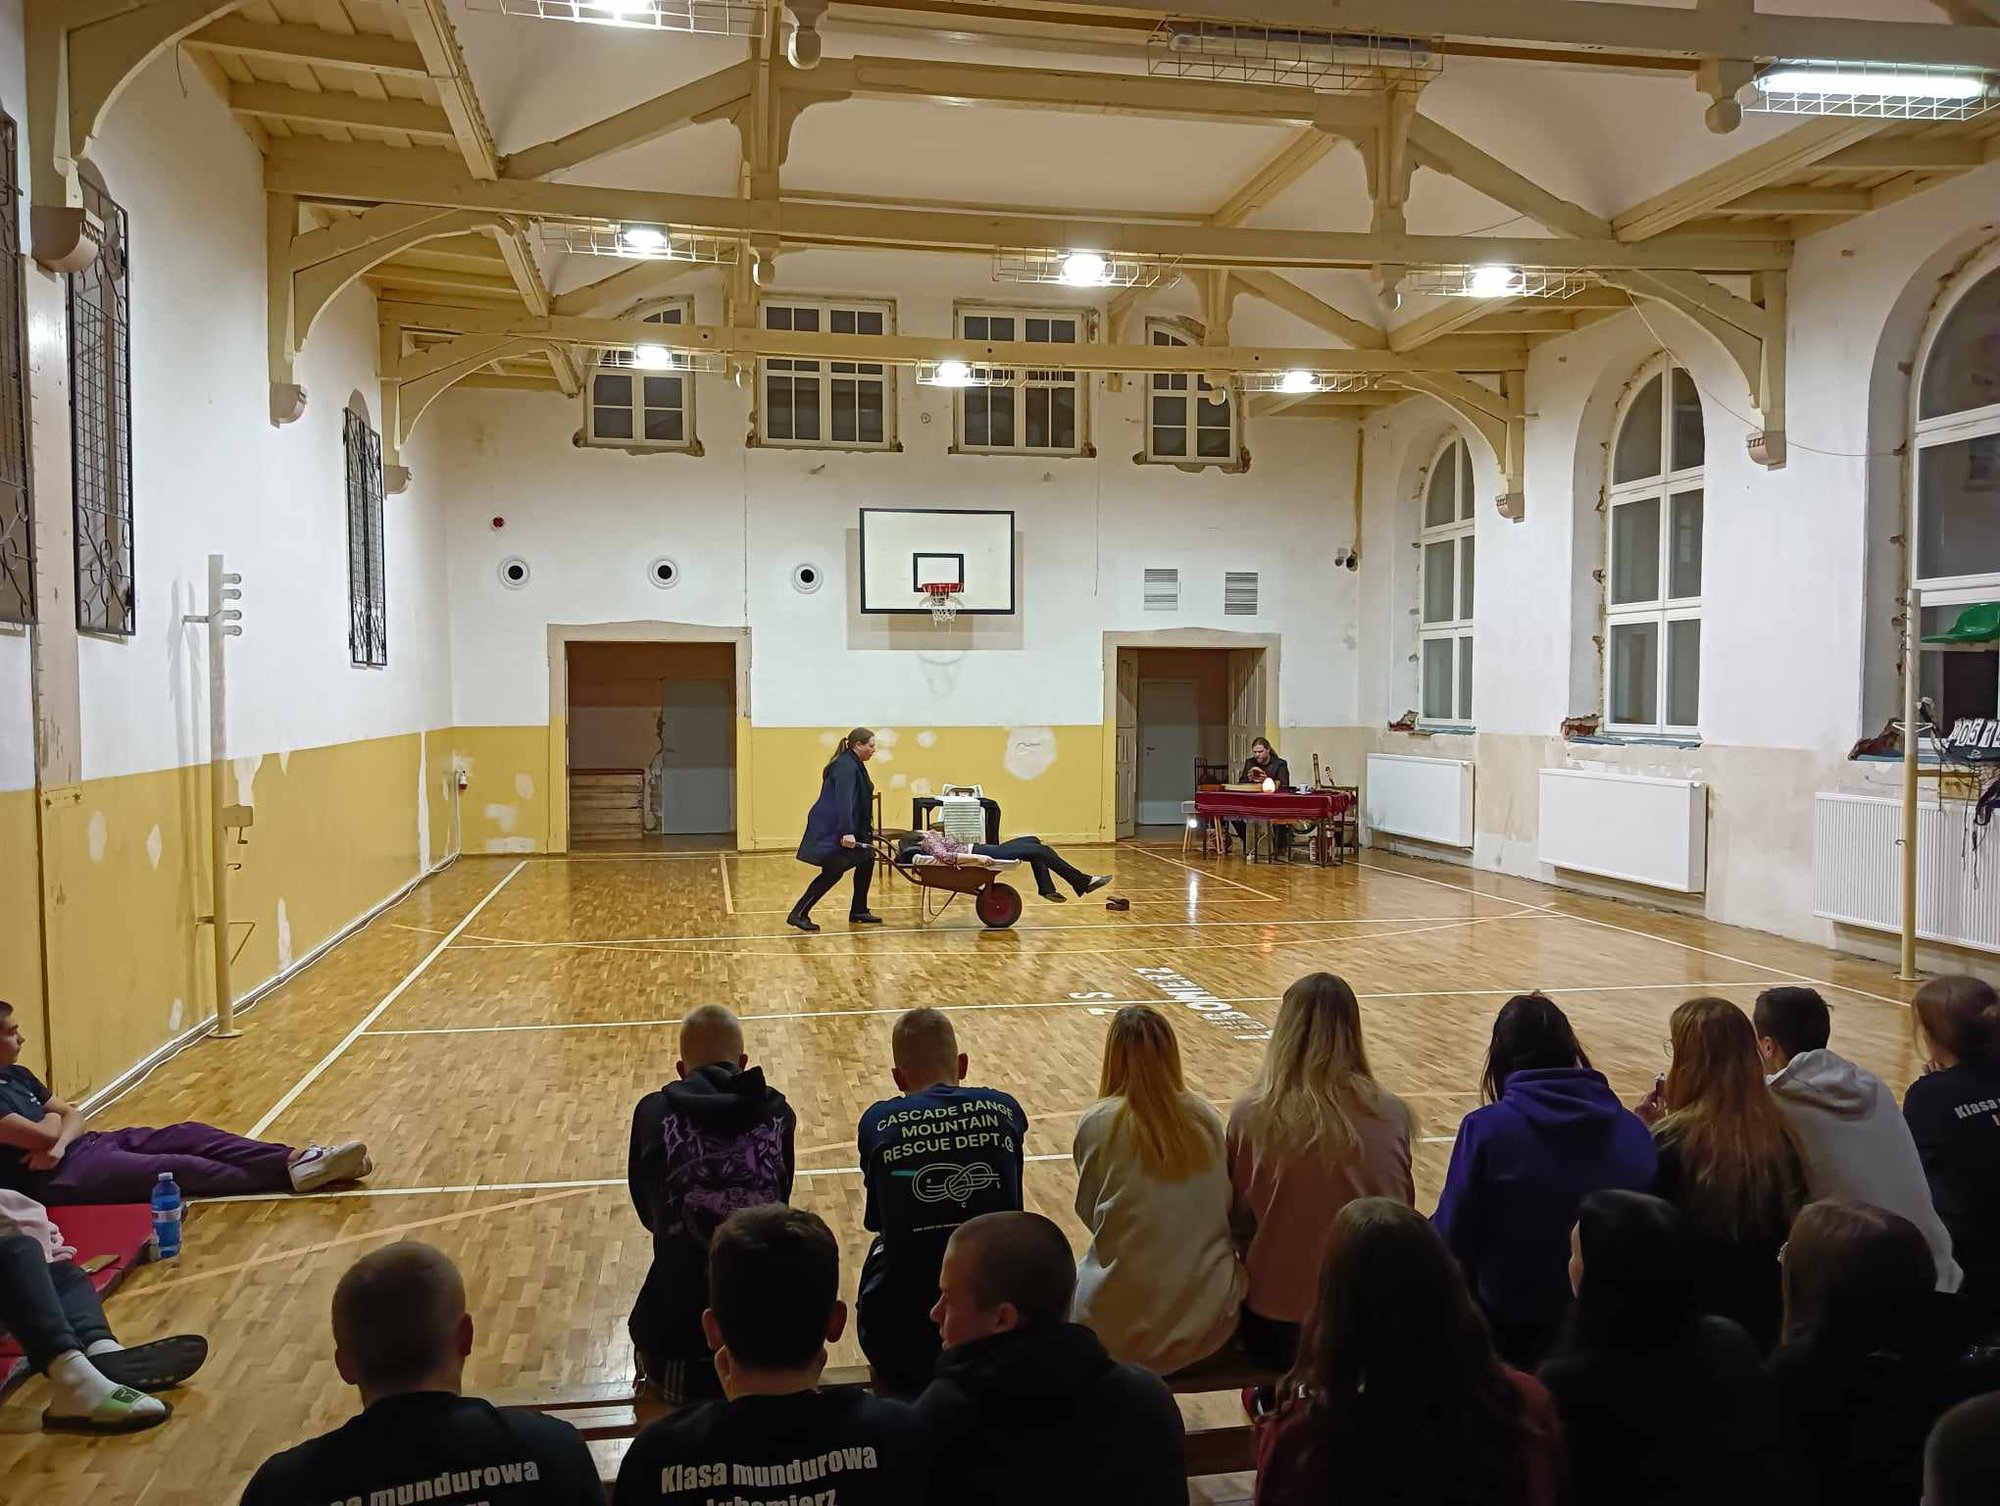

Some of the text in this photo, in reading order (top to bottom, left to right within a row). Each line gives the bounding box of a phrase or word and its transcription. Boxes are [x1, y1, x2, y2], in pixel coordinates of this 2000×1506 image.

[876, 1099, 1014, 1132] CASCADE RANGE
[1954, 1099, 1998, 1119] Klasa
[901, 1114, 999, 1138] MOUNTAIN
[883, 1137, 951, 1164] RESCUE
[370, 1460, 540, 1506] mundurowa
[661, 1446, 878, 1494] Klasa mundurowa
